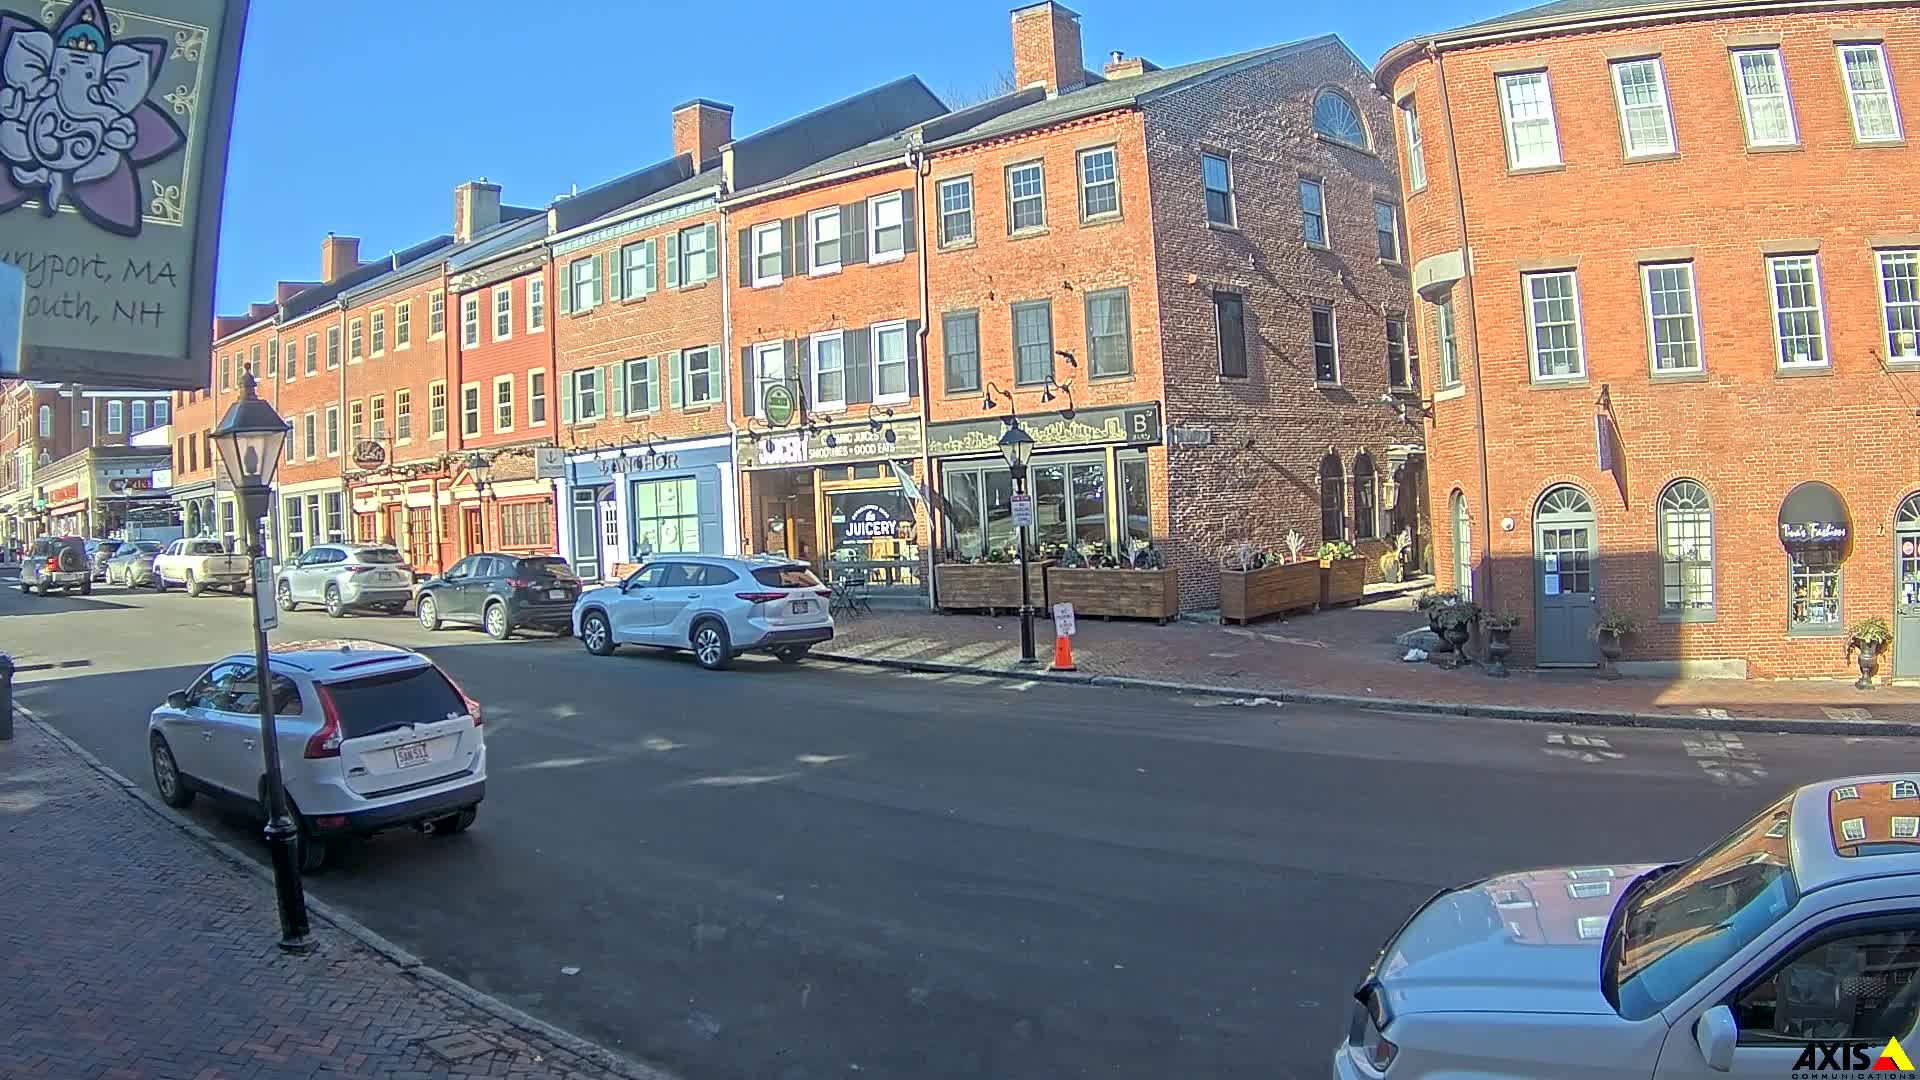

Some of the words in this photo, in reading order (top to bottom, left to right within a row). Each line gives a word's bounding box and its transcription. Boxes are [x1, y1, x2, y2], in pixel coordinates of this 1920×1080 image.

[122, 258, 177, 288] MA
[112, 300, 165, 328] NH
[845, 520, 897, 537] JUICERY
